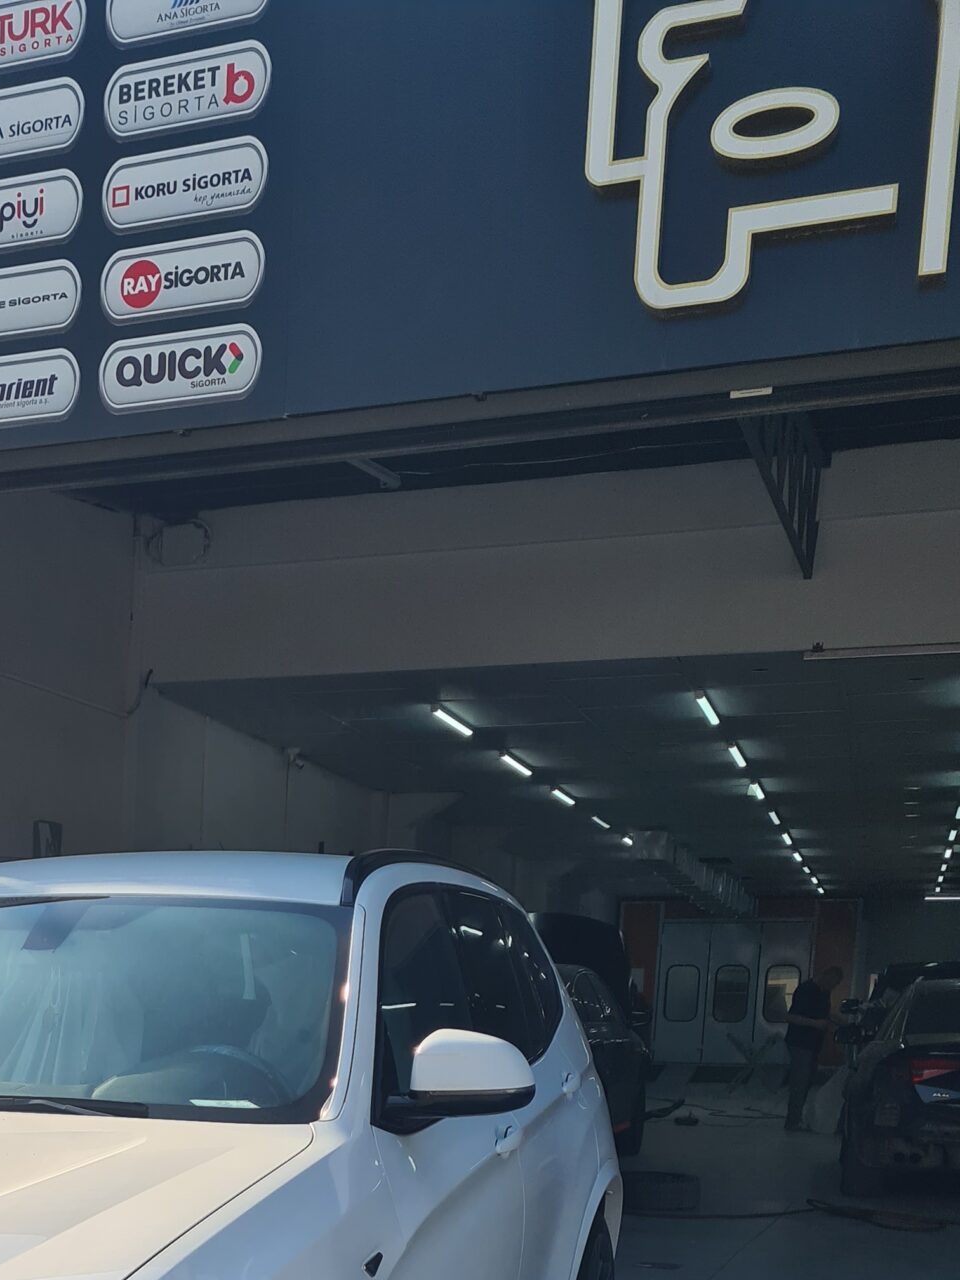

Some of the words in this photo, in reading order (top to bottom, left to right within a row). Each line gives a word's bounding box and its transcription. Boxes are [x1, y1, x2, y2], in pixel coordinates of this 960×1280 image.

[156, 11, 179, 23] ANA
[118, 65, 221, 105] BEREKET
[134, 180, 177, 201] KORU
[123, 272, 161, 296] RAY
[115, 343, 228, 388] QUICK
